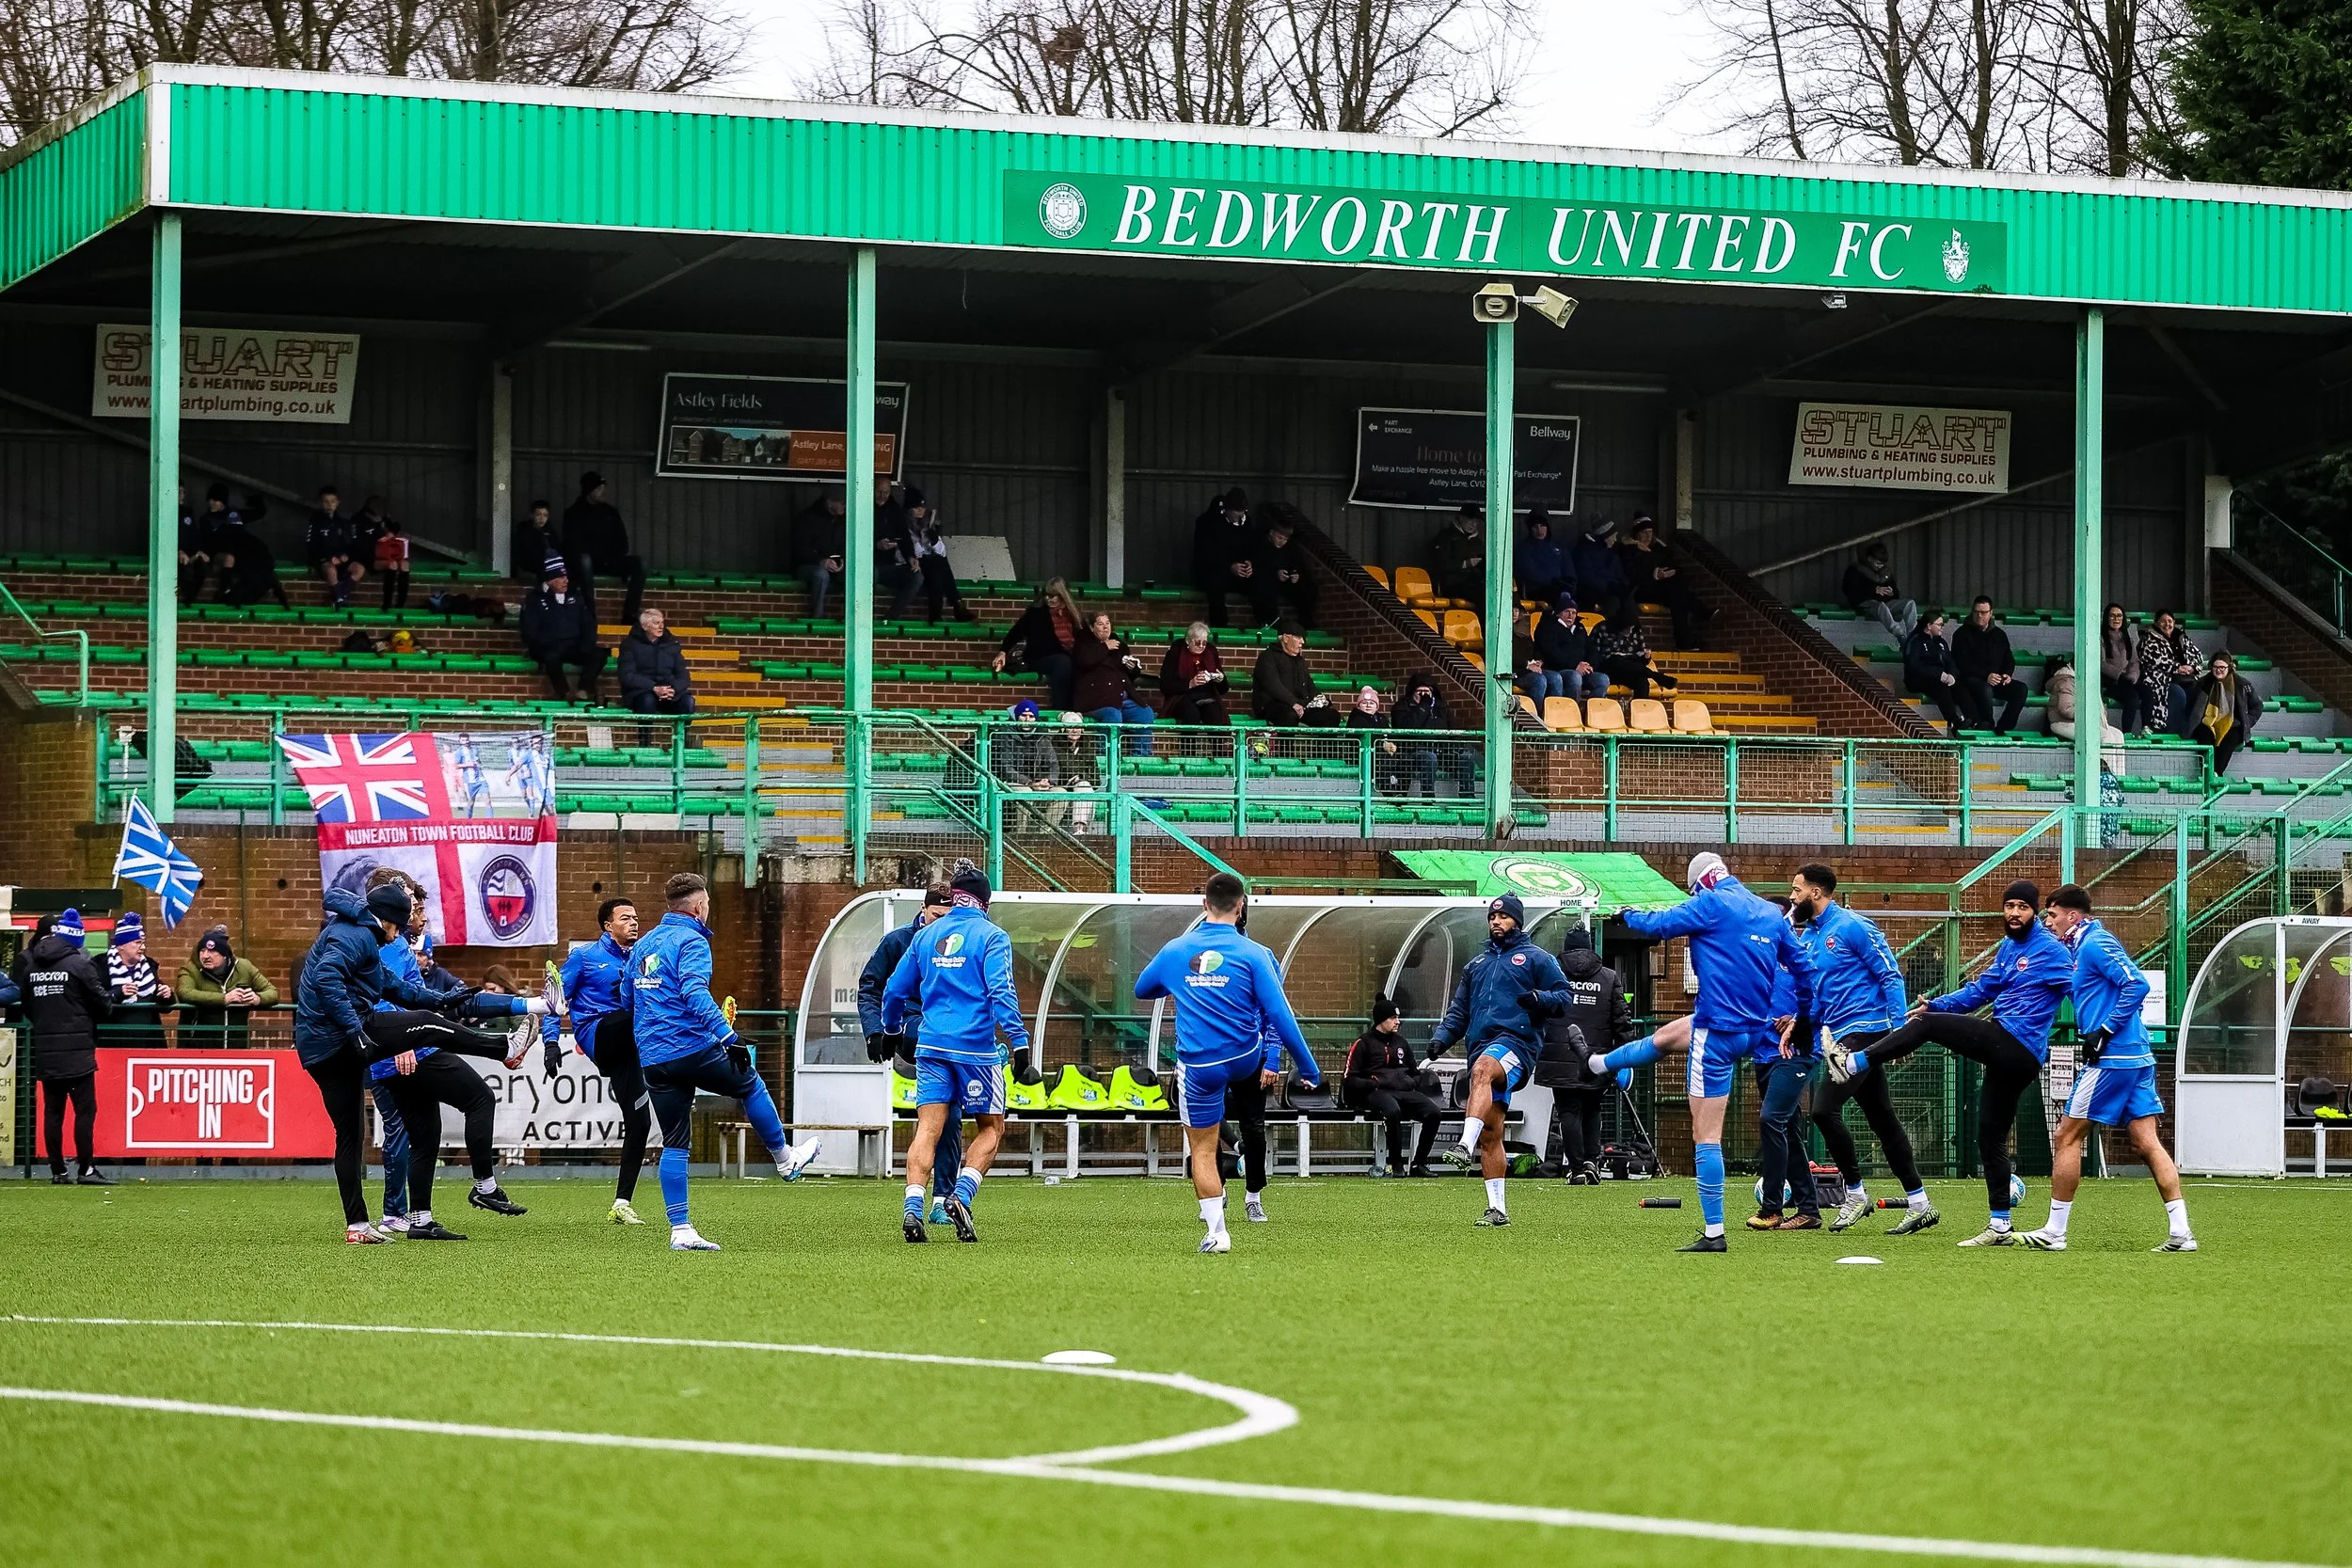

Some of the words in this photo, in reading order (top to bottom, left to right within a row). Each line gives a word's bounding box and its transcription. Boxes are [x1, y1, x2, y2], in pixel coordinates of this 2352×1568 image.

[1110, 184, 1509, 262] BEDWORTH
[1548, 208, 1796, 274] UNITED
[1829, 221, 1913, 281] FC
[102, 332, 354, 380] SUART
[189, 377, 199, 388] &
[202, 377, 265, 391] HEATING
[271, 380, 338, 394] SUPPLIES
[107, 395, 336, 418] www.artplumbing.co.uk
[674, 390, 717, 412] Astley
[721, 392, 764, 410] Fields
[1384, 427, 1413, 436] EXCHANGE
[1530, 425, 1571, 442] Bellway
[1801, 410, 2006, 452] STUART
[792, 440, 819, 451] Astley
[1415, 446, 1464, 463] Home
[1803, 449, 1867, 460] PLUMBING
[1870, 450, 1880, 460] &
[1884, 451, 1936, 463] HEATING
[1940, 453, 1996, 466] SUPPLIES
[1372, 464, 1389, 473] Make
[1396, 466, 1416, 474] hassle
[1416, 466, 1429, 474] free
[1458, 467, 1478, 478] Astley
[1802, 465, 1995, 486] www.stuartplumbing.co.uk
[1429, 478, 1450, 488] Astley
[345, 827, 408, 846] NUNEATON
[410, 826, 448, 842] TOWN
[451, 824, 507, 840] FOOTBALL
[509, 826, 534, 843] CLUB
[29, 971, 69, 983] macron
[1569, 980, 1601, 992] acron
[148, 1068, 254, 1104] PITCHING
[199, 1103, 222, 1139] IN
